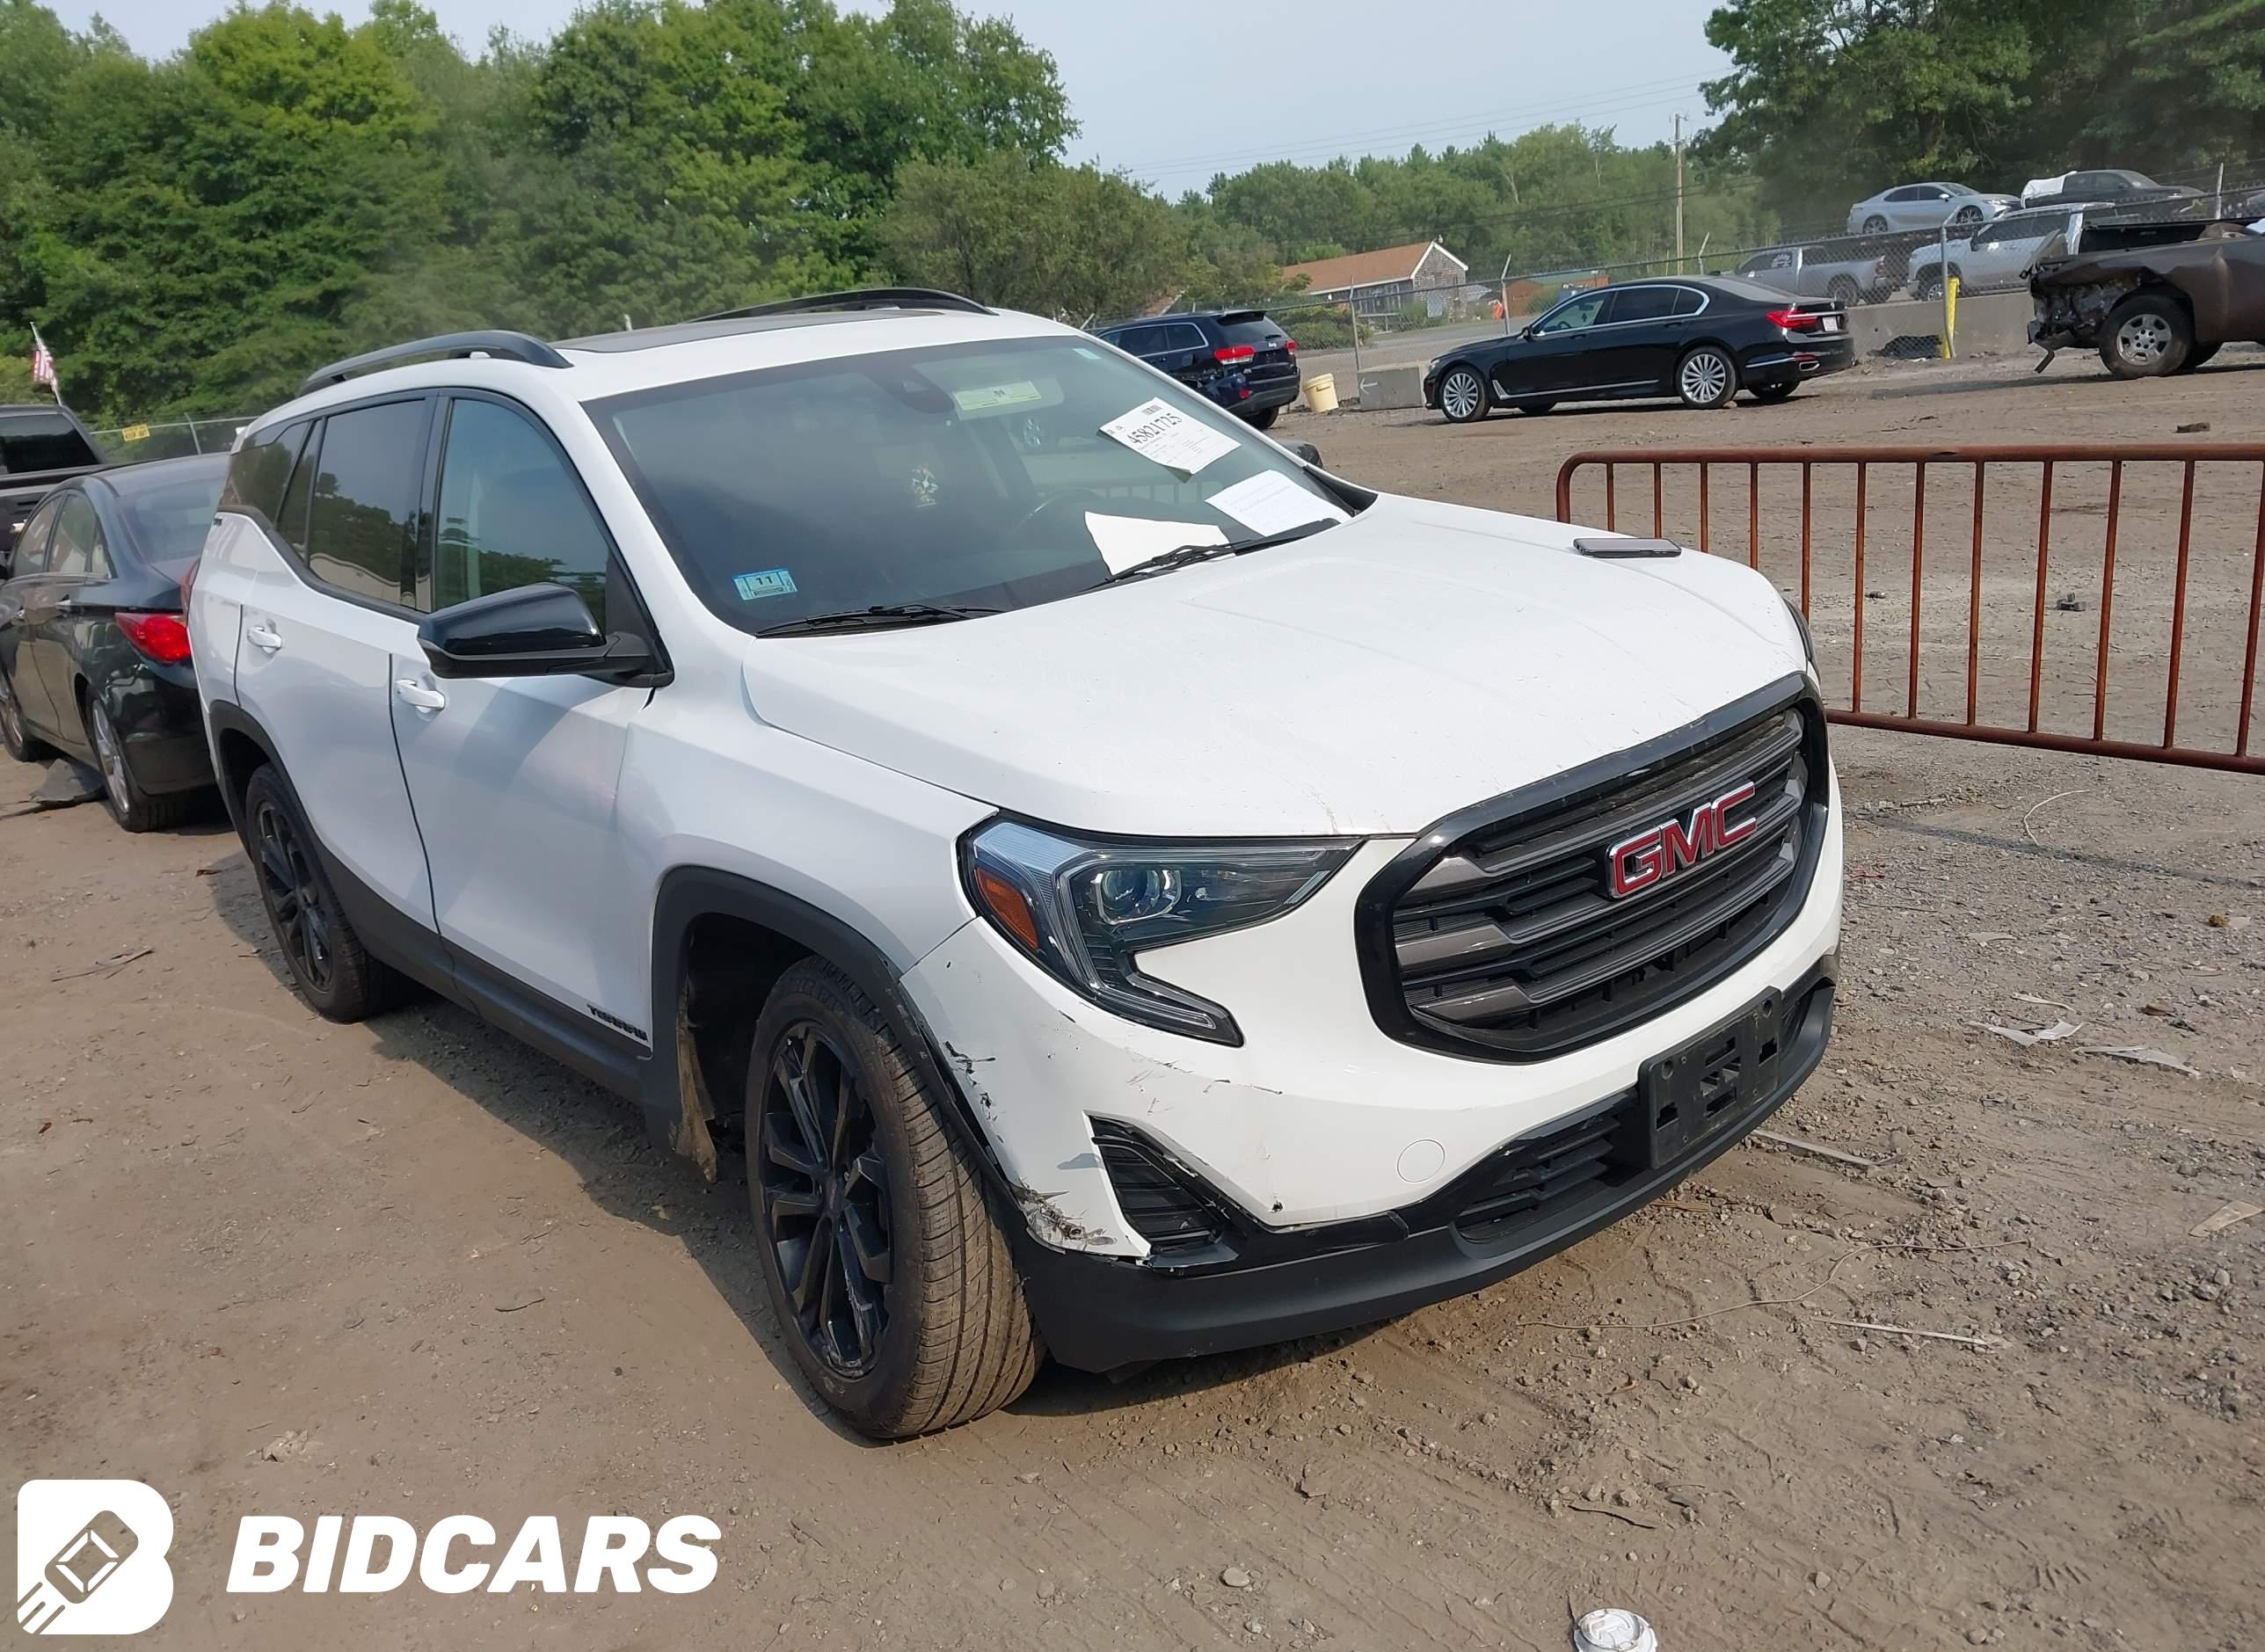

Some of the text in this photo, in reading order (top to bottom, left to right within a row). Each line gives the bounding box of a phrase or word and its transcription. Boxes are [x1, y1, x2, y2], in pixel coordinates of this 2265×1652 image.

[1126, 412, 1183, 445] 45821725
[755, 576, 773, 585] 11
[1606, 782, 1757, 899] GMC
